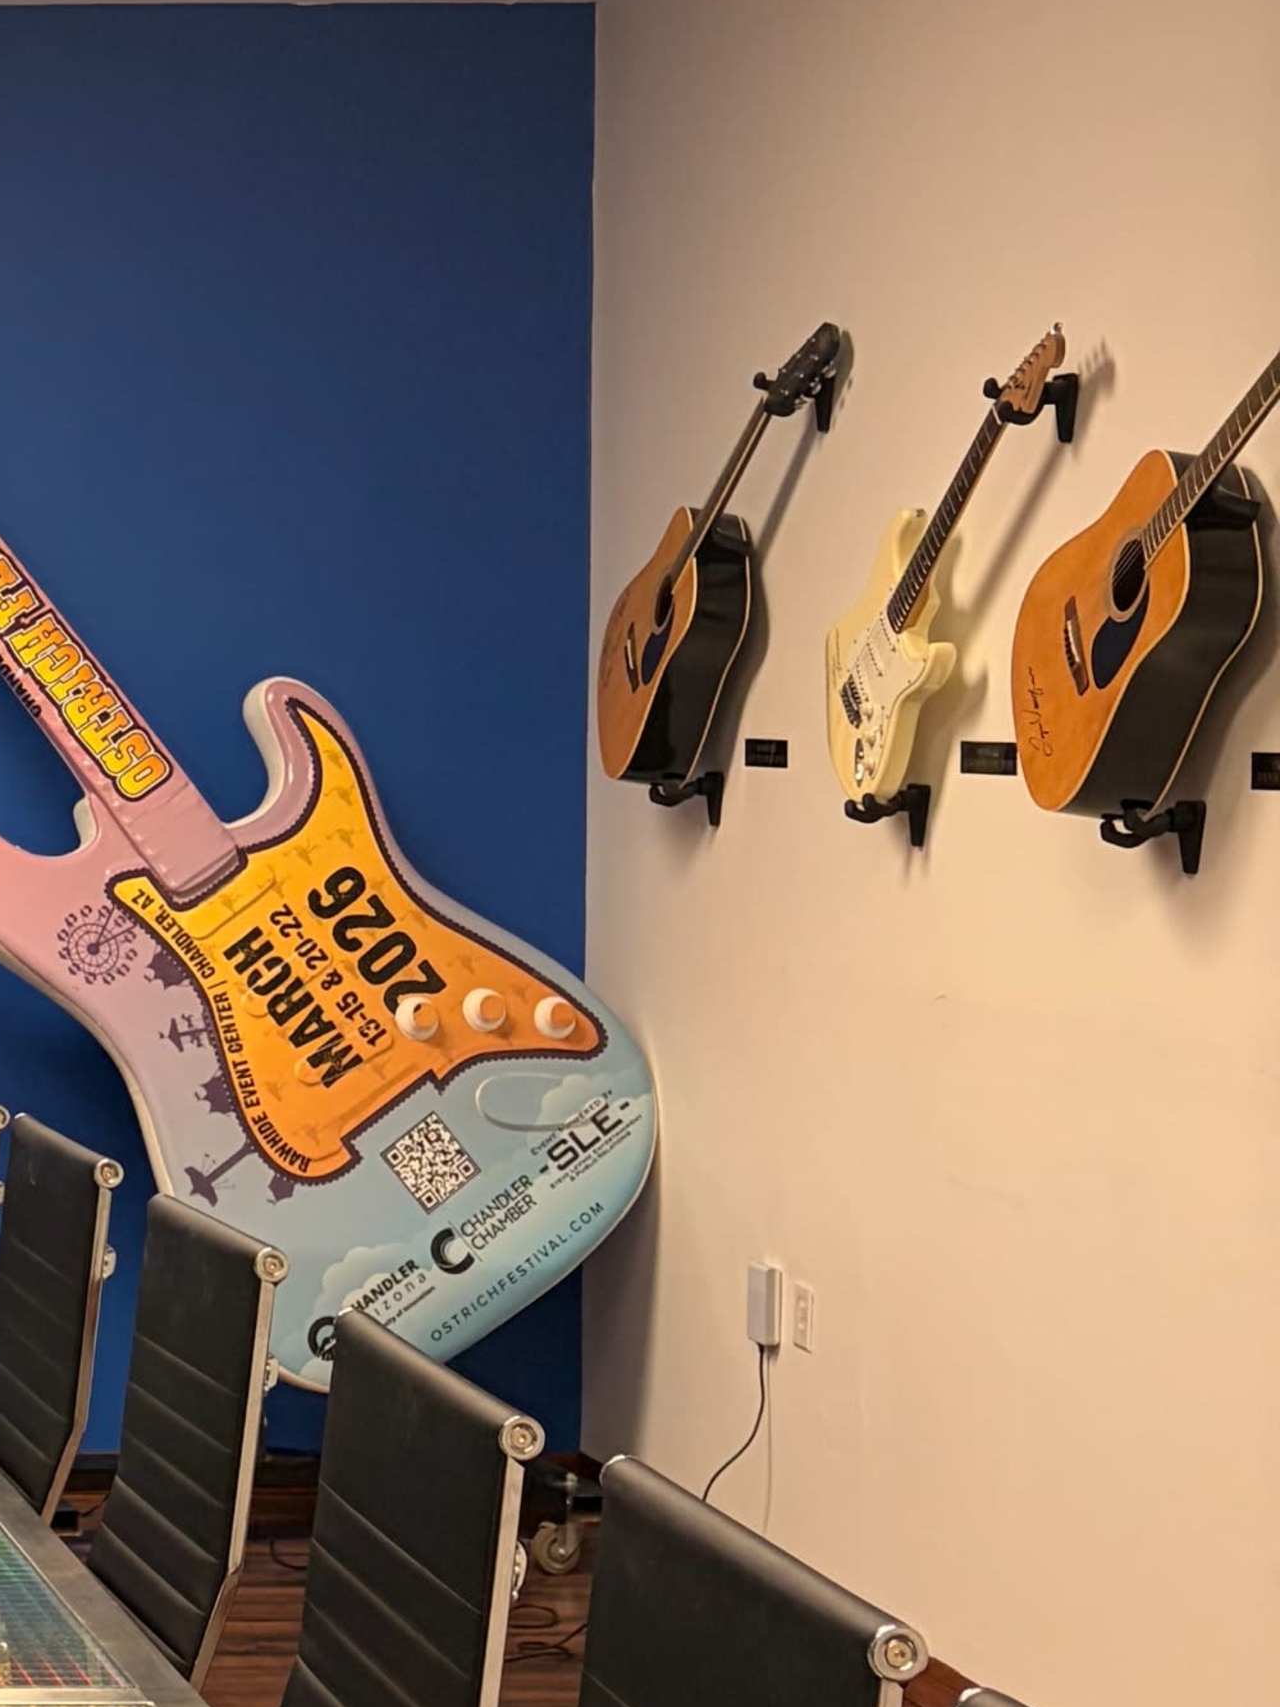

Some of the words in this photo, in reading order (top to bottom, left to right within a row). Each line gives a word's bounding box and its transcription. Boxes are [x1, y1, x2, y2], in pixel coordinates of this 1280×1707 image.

[7, 612, 169, 800] OSTRICH
[130, 887, 156, 912] AZ
[153, 900, 217, 980] CHANDLER,
[268, 902, 329, 971] 20-22
[306, 865, 448, 1017] 2026
[222, 925, 365, 1089] MARCH
[319, 967, 344, 991] &
[212, 992, 245, 1059] CENTER
[335, 990, 388, 1047] 13-15
[230, 1059, 262, 1110] EVENT
[250, 1108, 312, 1174] RAWHIDE
[459, 1173, 534, 1238] CHANDLER
[469, 1194, 538, 1252] CHAMBER
[350, 1258, 421, 1312] HANDLER
[430, 1201, 607, 1344] OSTRICHFESTIVAL.COM
